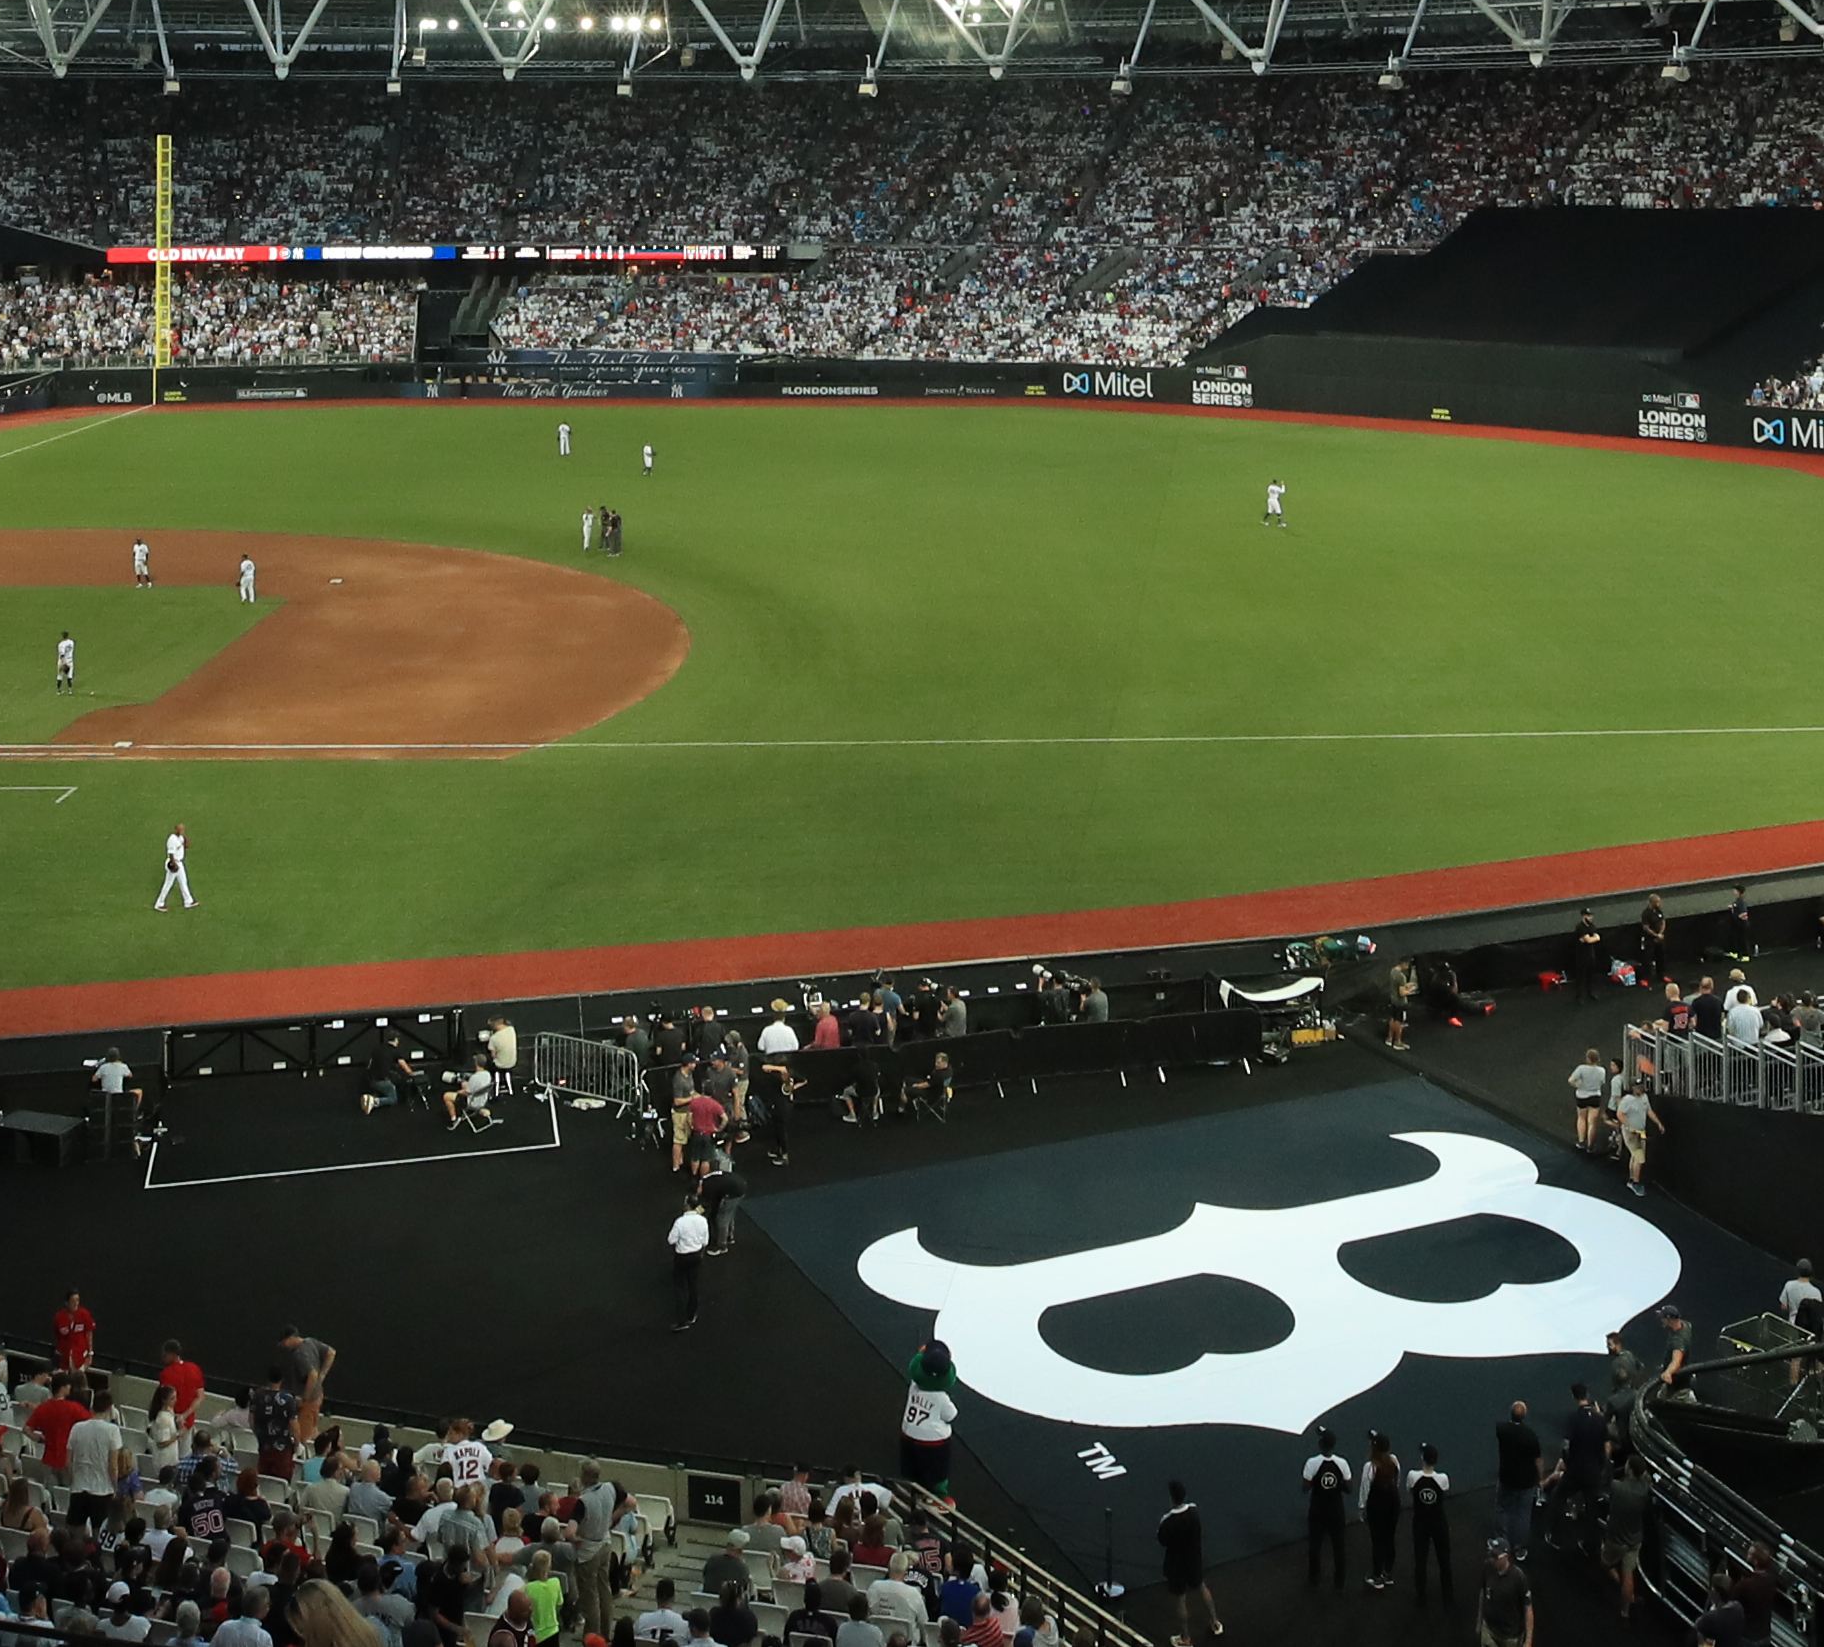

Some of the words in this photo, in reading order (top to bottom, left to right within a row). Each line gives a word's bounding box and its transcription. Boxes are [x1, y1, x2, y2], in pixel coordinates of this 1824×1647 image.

[147, 248, 179, 261] OLD
[182, 248, 245, 260] RIVALRY
[502, 386, 527, 398] New
[529, 386, 559, 399] York
[561, 385, 608, 399] Yankees
[781, 385, 878, 396] #LONDONSERIES
[1095, 371, 1154, 399] Mitel
[1192, 380, 1252, 395] LONDON
[96, 391, 132, 404] @MLB
[1192, 392, 1243, 407] SERIES
[1638, 409, 1706, 428] LONDON
[1638, 424, 1695, 441] SERIES
[856, 1131, 1682, 1434] B
[911, 1395, 935, 1411] WALLY
[906, 1406, 930, 1426] 97
[454, 1447, 480, 1460] NAPOLI
[1077, 1441, 1127, 1480] TM
[458, 1460, 479, 1480] 12
[704, 1494, 724, 1506] 114
[190, 1509, 224, 1537] 50
[100, 1530, 116, 1549] 99
